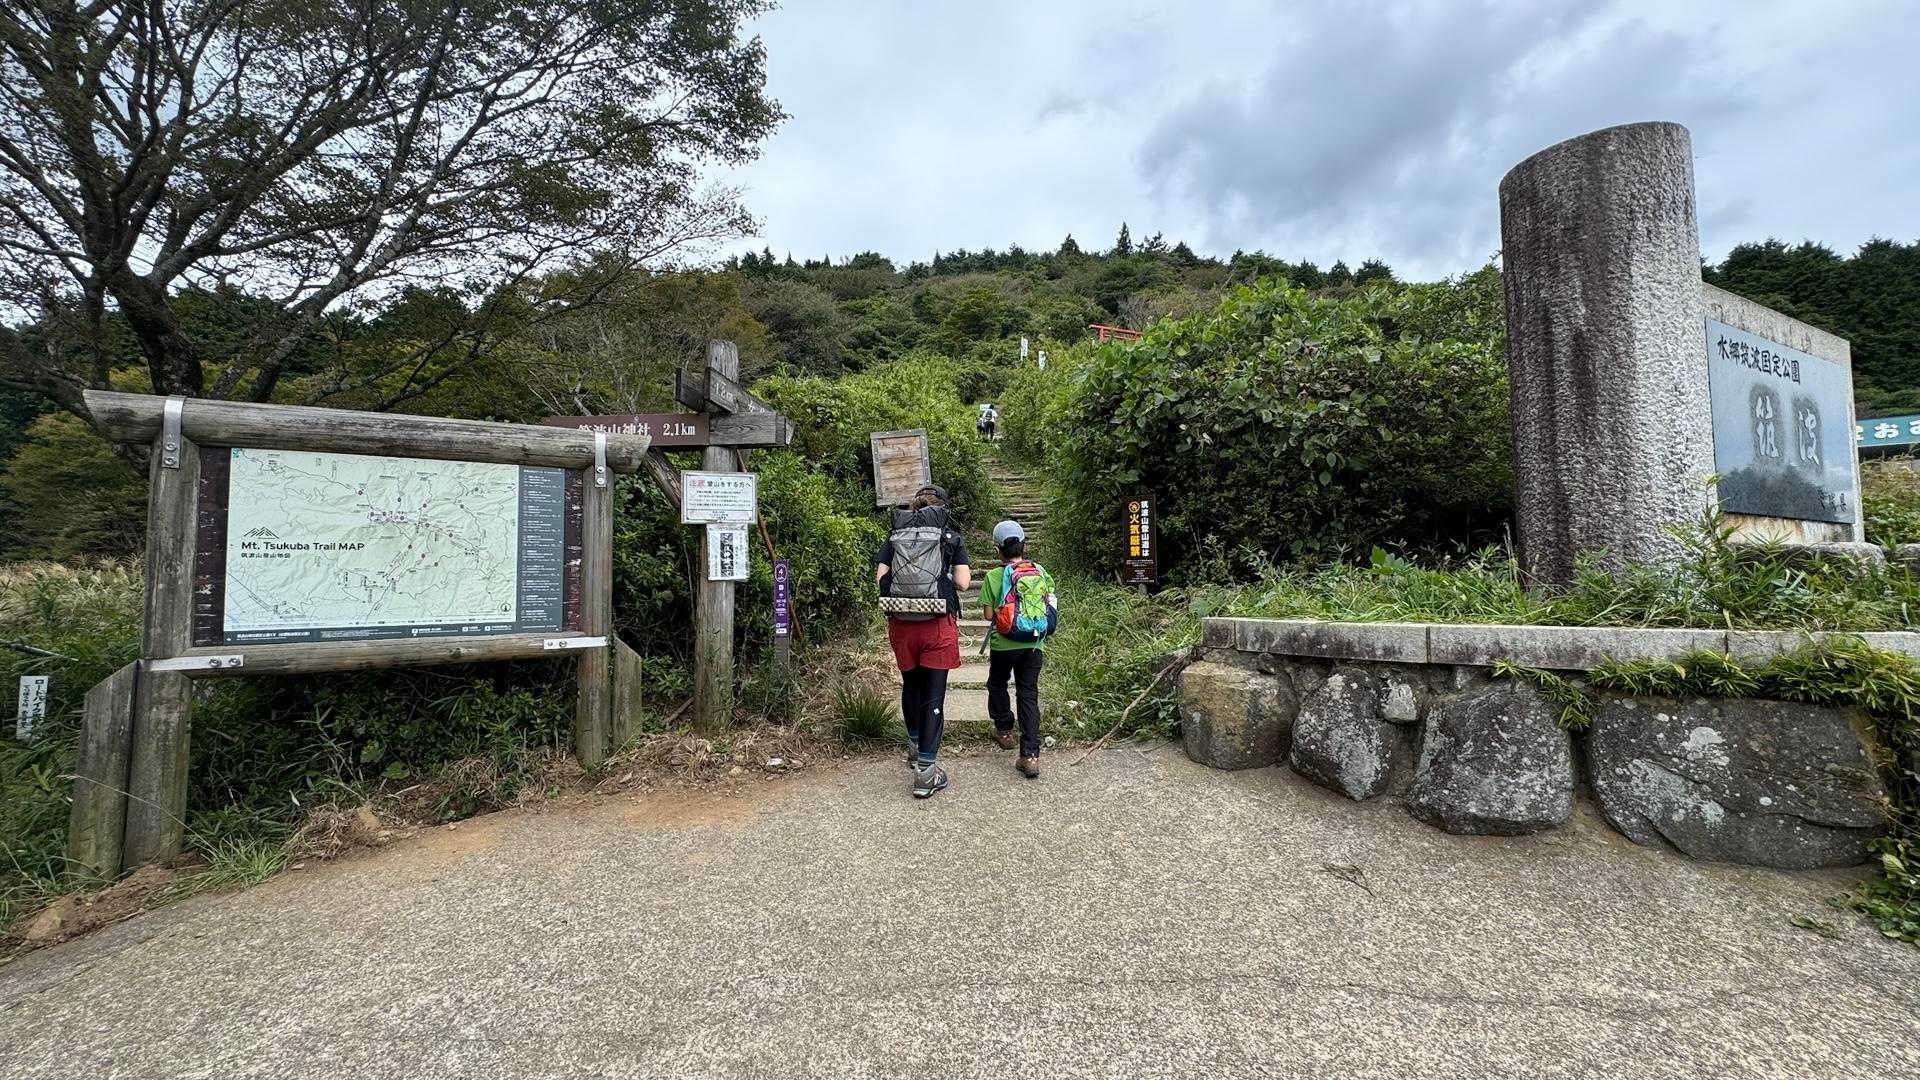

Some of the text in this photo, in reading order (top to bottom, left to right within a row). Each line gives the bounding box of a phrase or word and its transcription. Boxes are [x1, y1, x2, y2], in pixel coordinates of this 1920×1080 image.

[1717, 334, 1801, 385] 水郷筑波国定公園
[663, 423, 696, 437] 2.1km
[241, 541, 365, 551] Mt. Tsukuba Trail MAP
[1129, 513, 1140, 557] 火気厳禁
